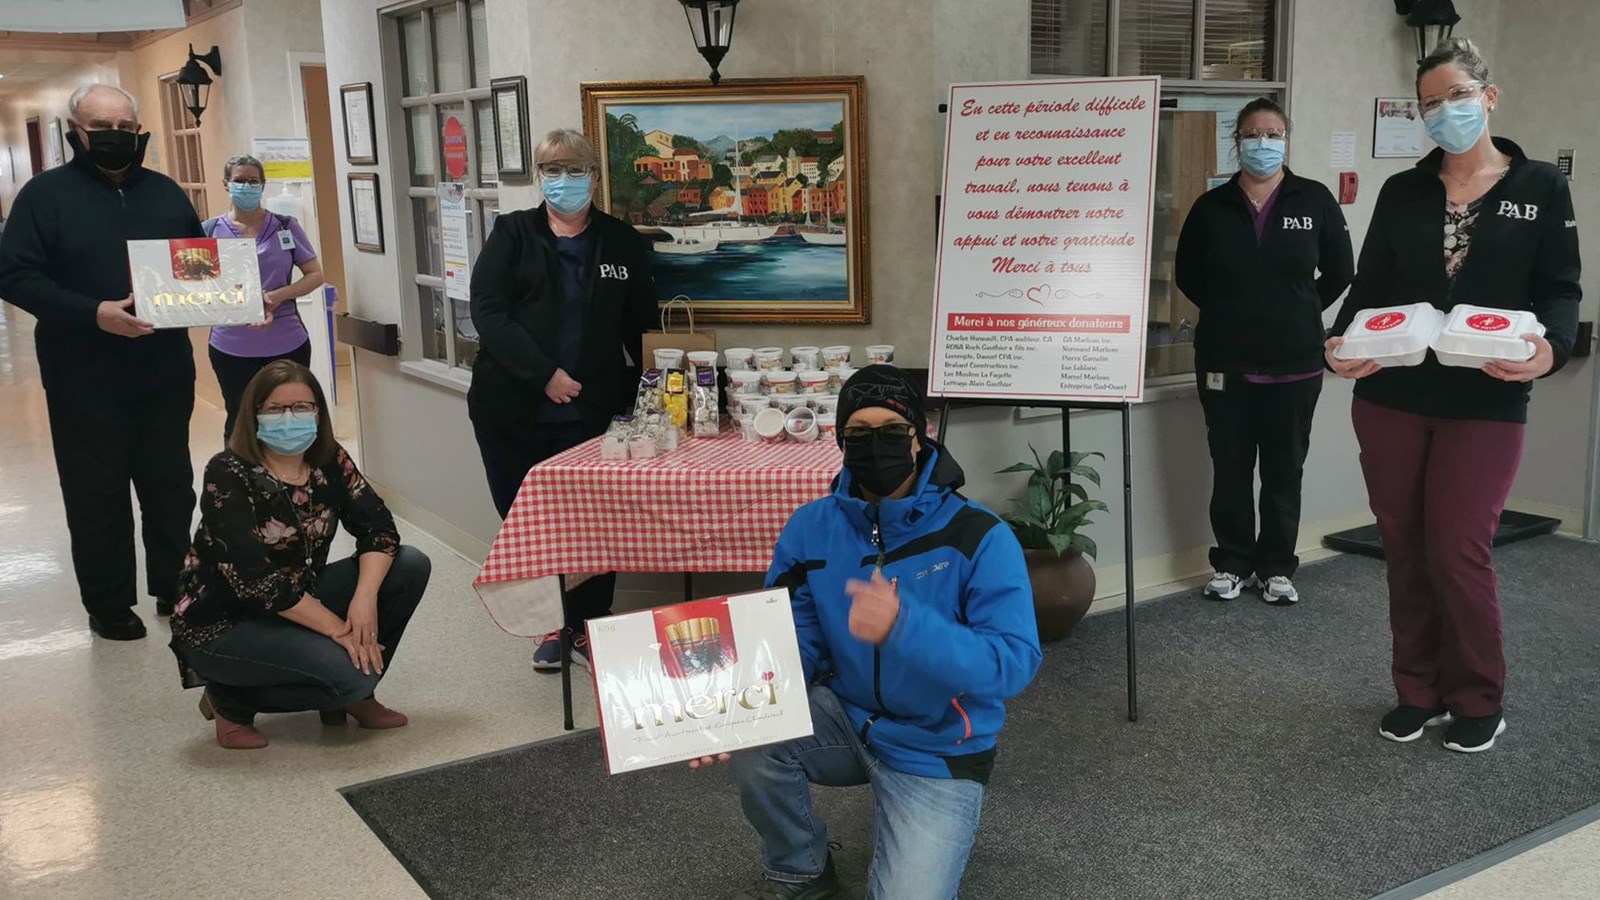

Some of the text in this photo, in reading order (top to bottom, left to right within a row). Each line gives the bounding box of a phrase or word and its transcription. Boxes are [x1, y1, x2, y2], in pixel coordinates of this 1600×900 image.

[960, 95, 1146, 118] En cette période difficile
[975, 126, 1127, 141] et en reconnaissance
[974, 150, 1122, 171] pour votre excellent
[964, 178, 1131, 195] travail, nous tenons à
[967, 205, 1125, 221] vous démontrer notre
[1496, 200, 1539, 222] PAB
[1282, 216, 1313, 231] PAB
[953, 231, 1136, 250] appui et notre gratitude
[599, 263, 629, 280] PAB
[992, 256, 1093, 274] Merci à tous
[153, 283, 245, 308] merci
[954, 315, 1124, 330] Merci à nos généreux donateurs
[633, 671, 778, 731] merci
